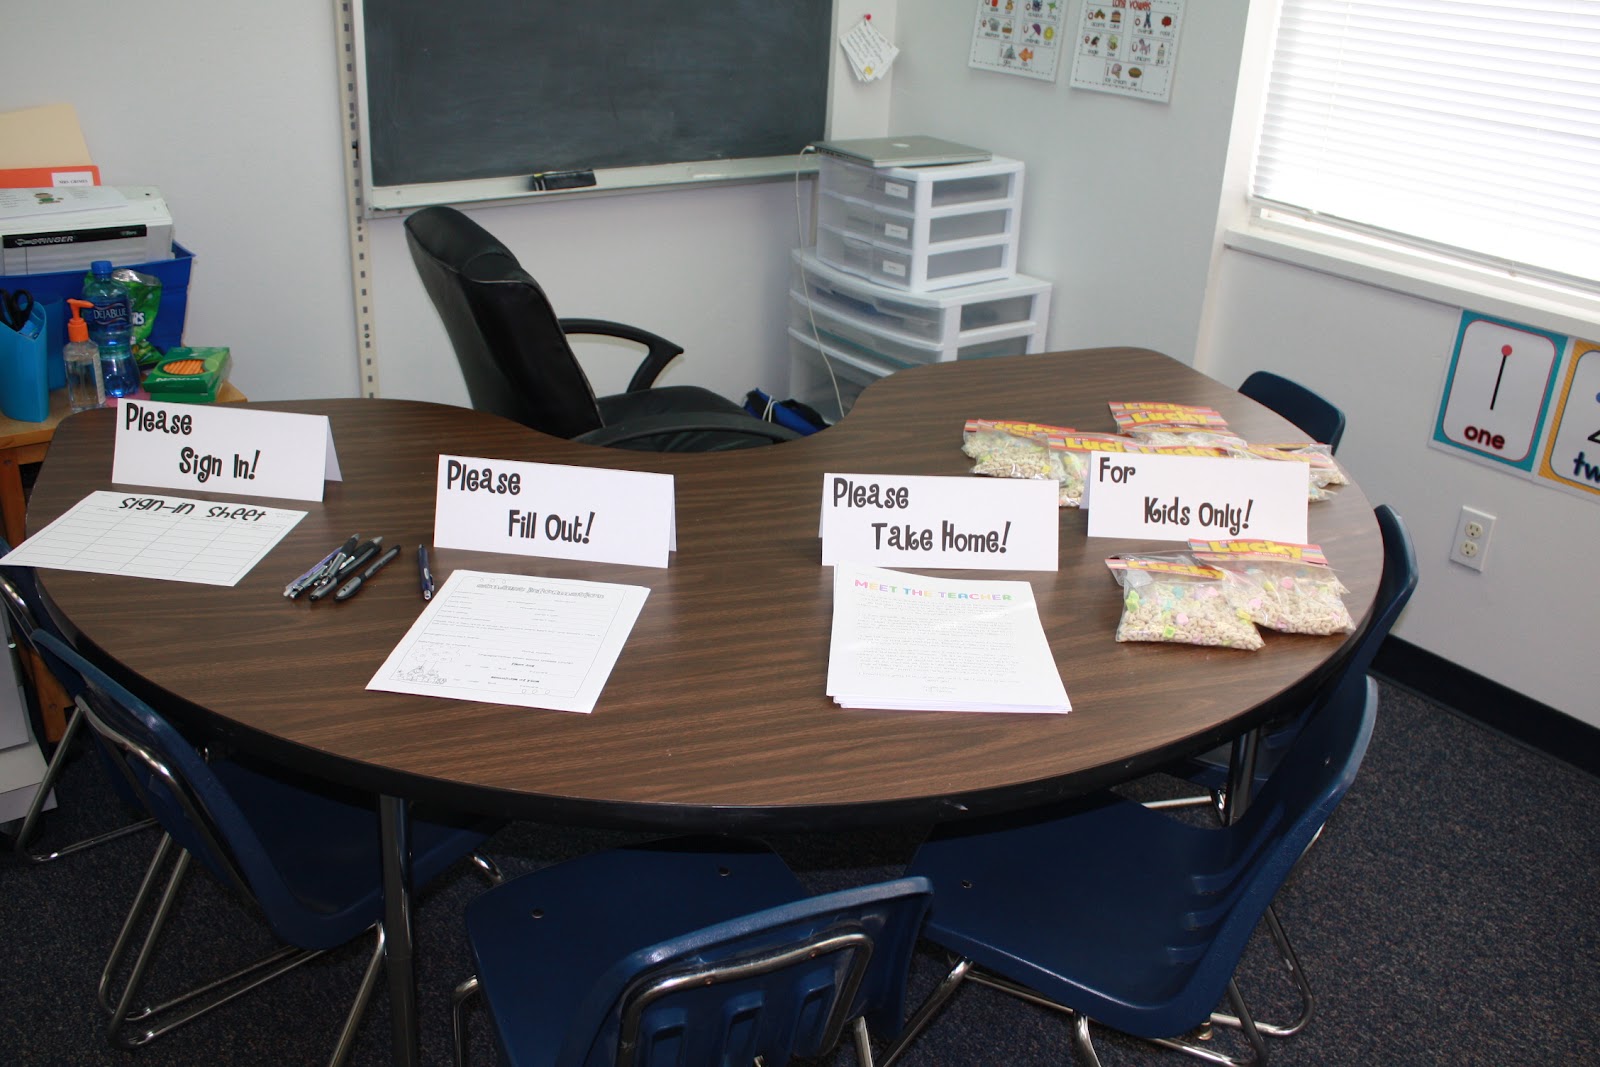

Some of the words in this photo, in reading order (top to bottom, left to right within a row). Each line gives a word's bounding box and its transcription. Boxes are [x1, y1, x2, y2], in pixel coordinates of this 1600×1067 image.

[126, 402, 192, 435] Please
[1464, 426, 1506, 450] one
[179, 447, 222, 483] Sign
[234, 450, 260, 480] In!
[447, 460, 521, 495] Please
[1100, 457, 1136, 484] For
[119, 497, 195, 515] sign-in
[206, 506, 267, 522] sheet
[833, 478, 909, 509] Please
[508, 510, 537, 539] Fill
[545, 512, 596, 544] Out!
[1144, 497, 1190, 525] Kids
[1198, 499, 1254, 536] Only!
[871, 523, 933, 551] Take
[942, 520, 1012, 553] Home!
[854, 579, 898, 594] MEET
[903, 587, 933, 597] THE
[938, 591, 1013, 601] TEACHER
